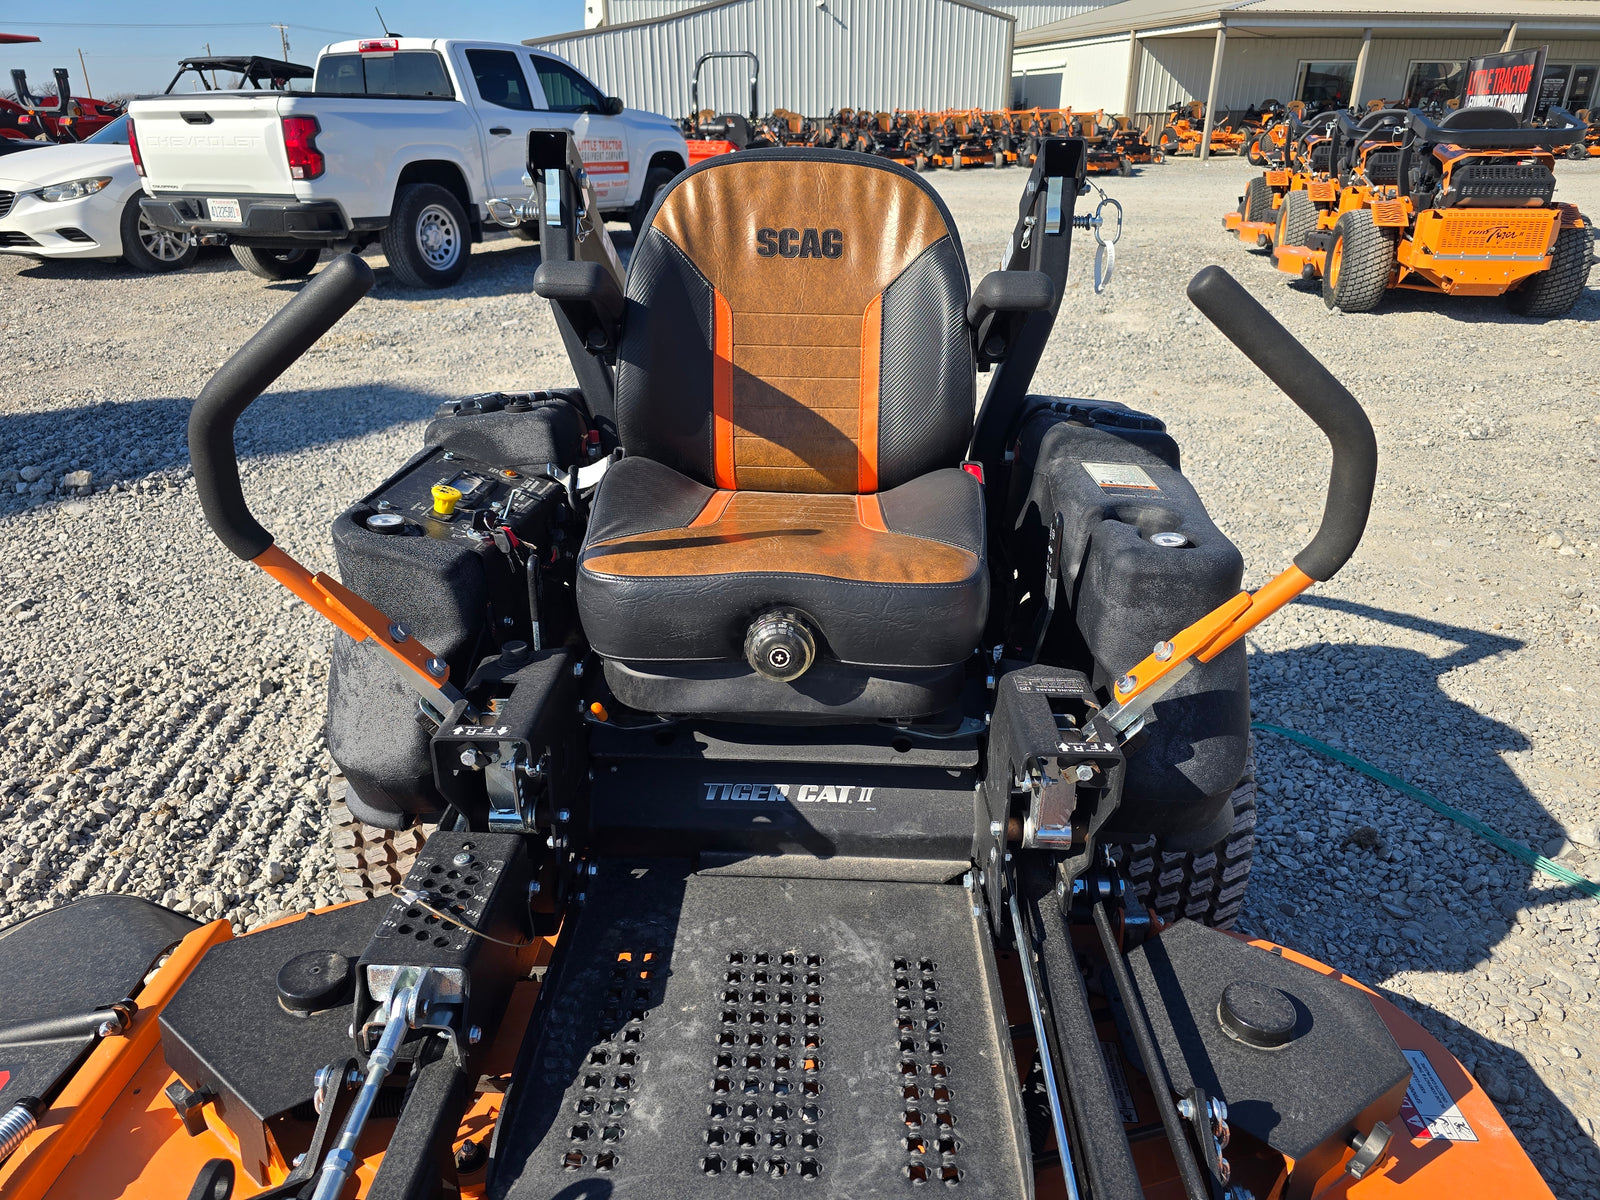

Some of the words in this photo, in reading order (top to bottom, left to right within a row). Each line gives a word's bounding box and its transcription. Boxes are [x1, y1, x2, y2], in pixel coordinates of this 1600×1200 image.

[1467, 68, 1495, 95] LITTLE
[146, 136, 261, 148] CHEVROLET
[598, 139, 622, 151] TRACTOR
[757, 227, 843, 259] SCAG
[703, 782, 790, 801] TIGER
